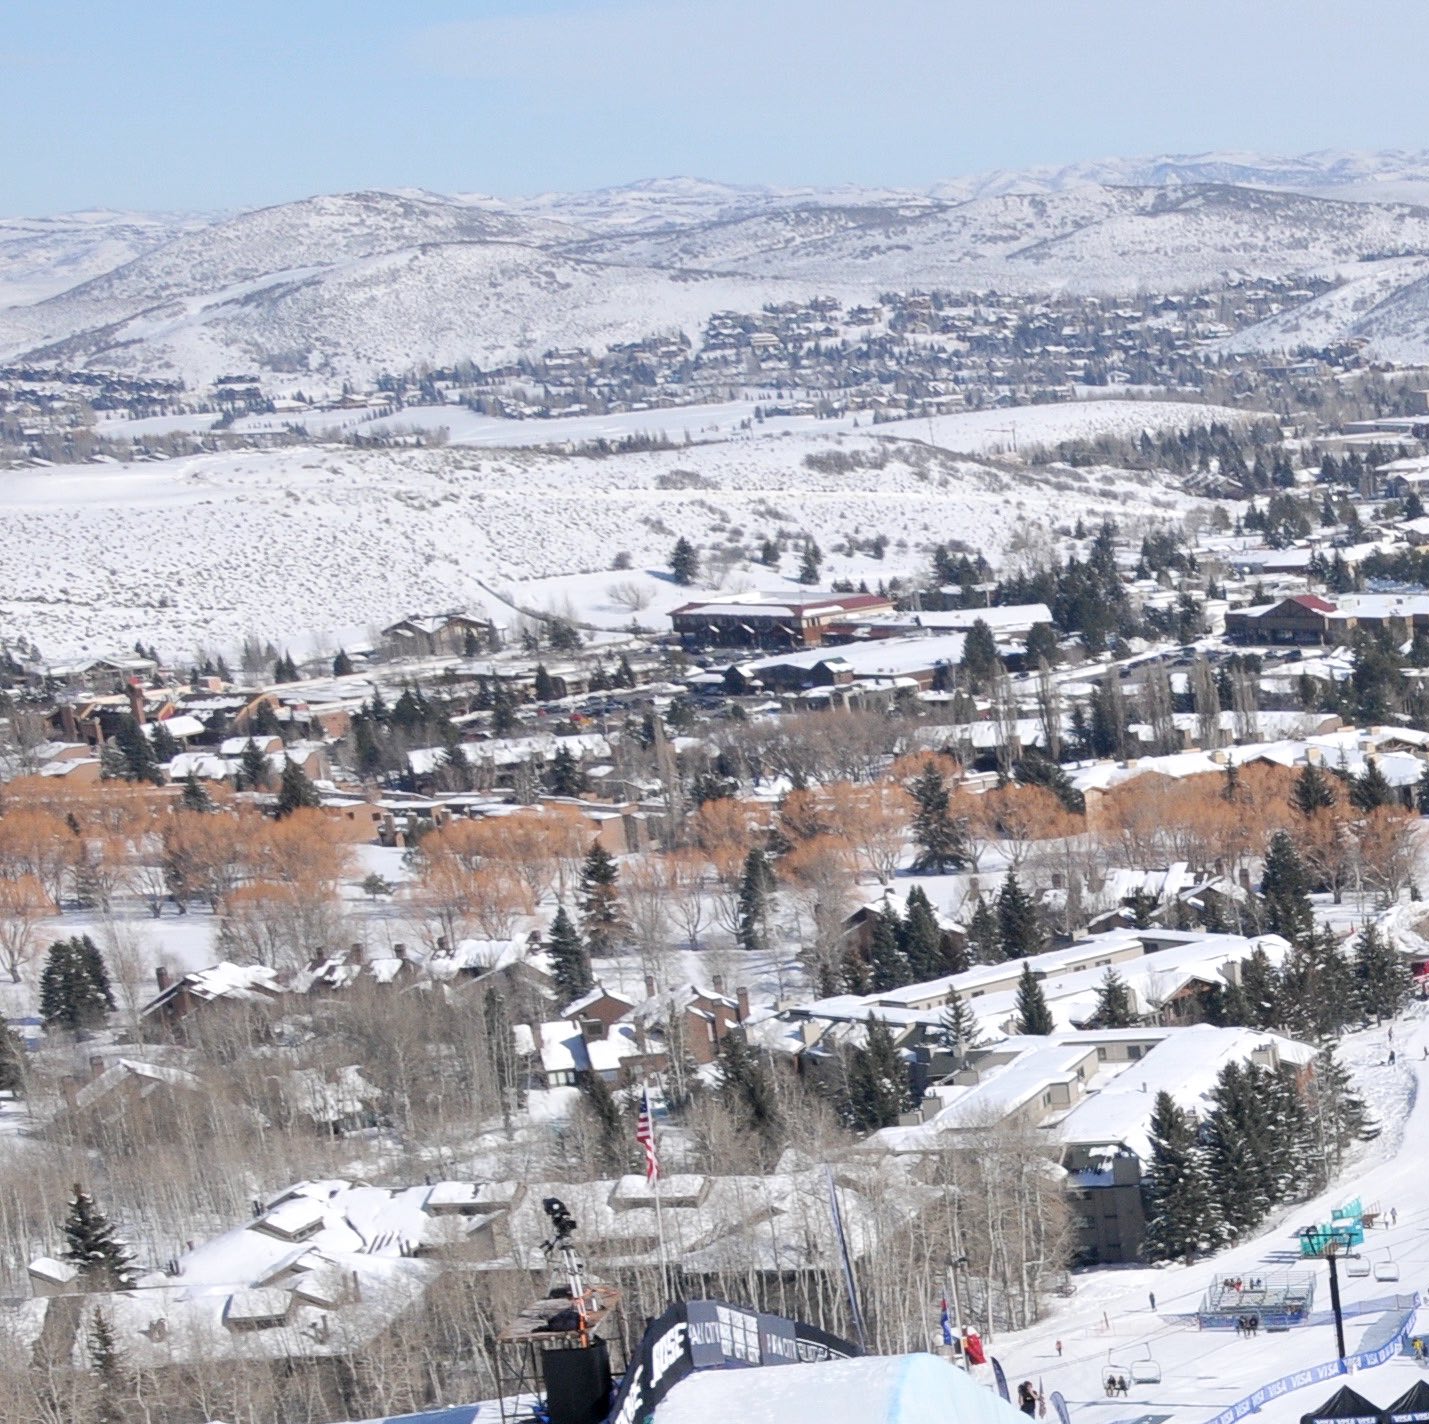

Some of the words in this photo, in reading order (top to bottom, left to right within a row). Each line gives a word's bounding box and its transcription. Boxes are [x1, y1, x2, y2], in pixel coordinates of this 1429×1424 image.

[1267, 1379, 1288, 1397] VISA
[1289, 1370, 1313, 1389] VISA
[1316, 1359, 1341, 1380] VISA
